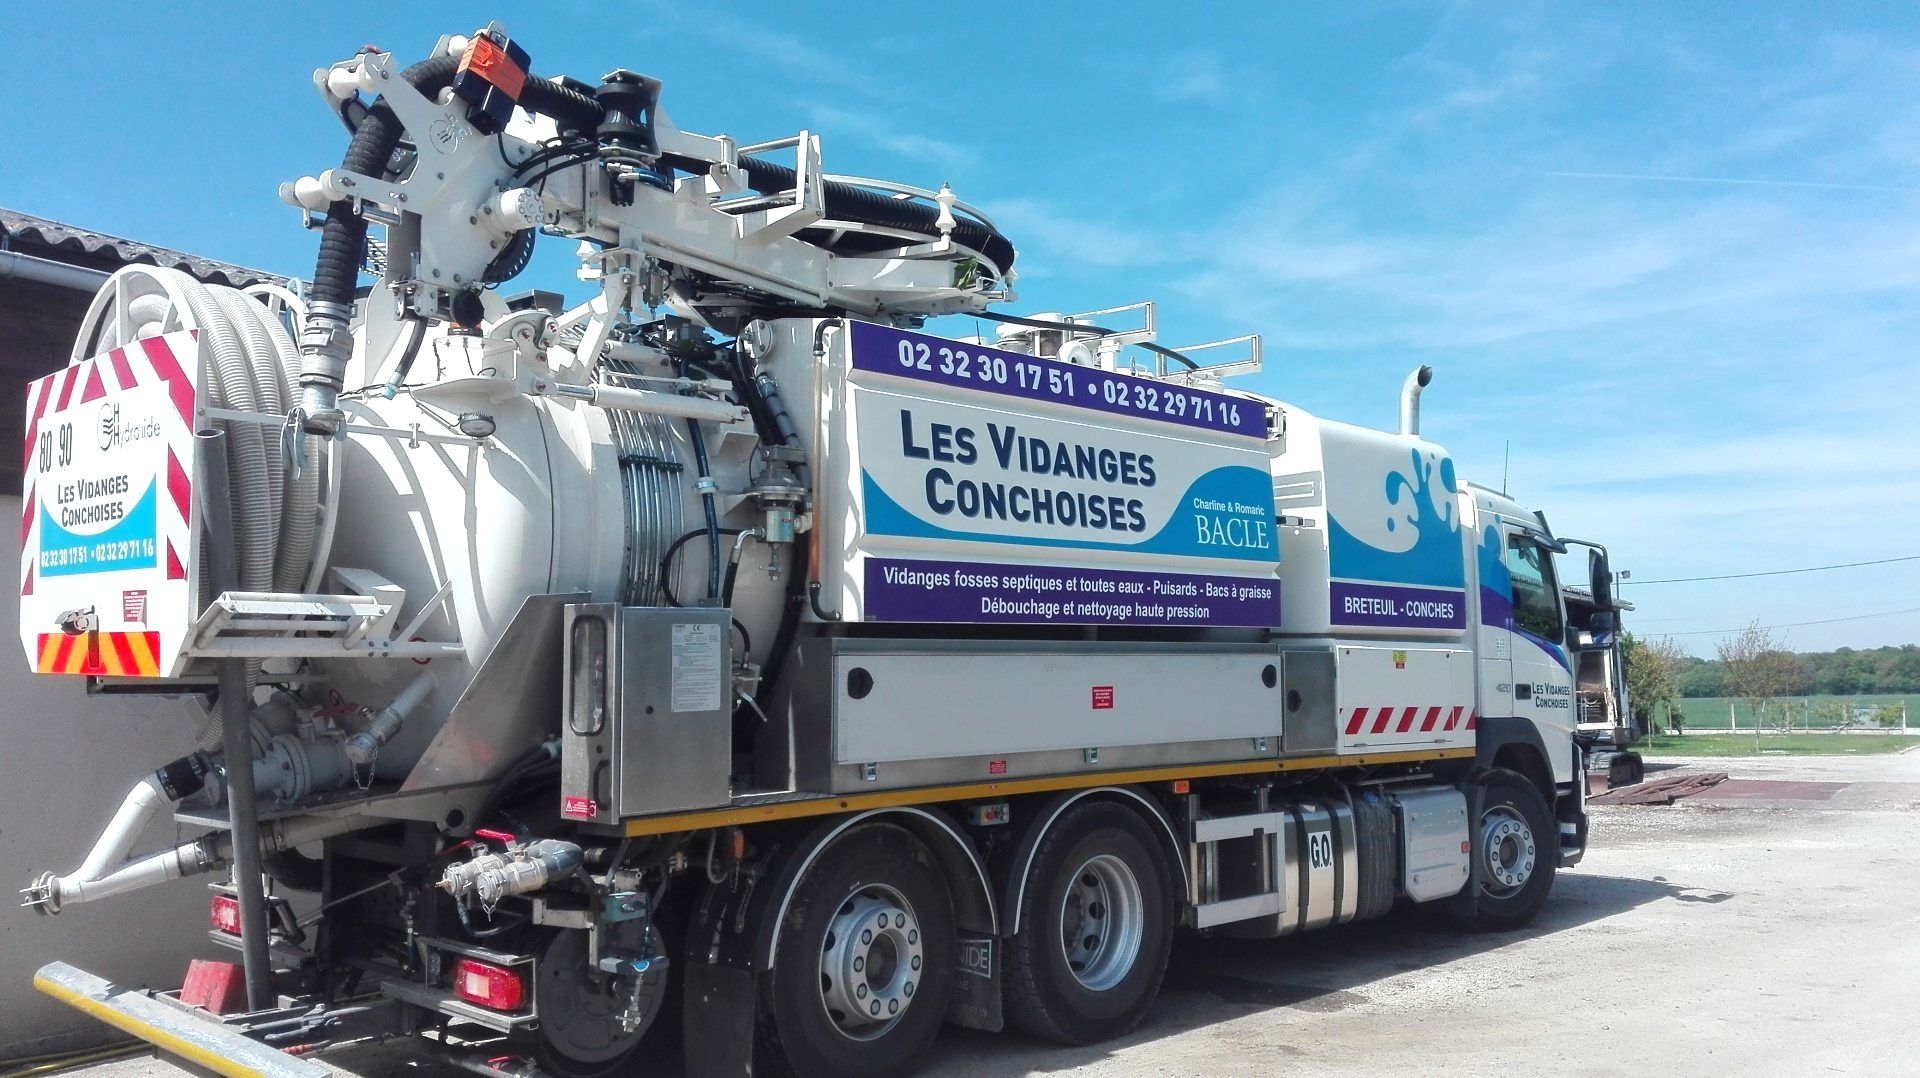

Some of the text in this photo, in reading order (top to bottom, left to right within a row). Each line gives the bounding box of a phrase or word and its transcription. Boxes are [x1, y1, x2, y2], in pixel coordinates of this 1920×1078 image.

[898, 339, 932, 371] 02
[938, 347, 971, 378] 32
[977, 355, 1008, 384] 30
[1014, 362, 1042, 390] 17
[1049, 368, 1075, 397] 51
[1103, 379, 1130, 407] 02
[1134, 385, 1159, 412] 32
[1163, 391, 1187, 416] 29
[1191, 396, 1213, 422] 71
[1219, 402, 1240, 427] 16
[40, 422, 73, 474] 80 90
[900, 409, 1157, 488] LES VIDANGES
[58, 474, 129, 504] LES VIDANGES
[925, 467, 1147, 533] CONCHOISES
[1193, 497, 1265, 516] Charline & Romaric
[62, 501, 124, 527] CONCHOISES
[1194, 514, 1269, 549] BACLE
[41, 551, 50, 567] 02
[50, 550, 59, 567] 32
[59, 548, 68, 565] 30
[95, 544, 106, 562] 02
[107, 543, 117, 560] 32
[118, 541, 128, 560] 29
[129, 540, 140, 558] 71
[142, 538, 154, 557] 16
[883, 566, 951, 590] Vidanges
[954, 569, 999, 588] fosses
[1002, 574, 1063, 593] septiques
[1065, 577, 1077, 591] et
[1079, 578, 1116, 593] toutes
[1118, 581, 1144, 594] eaux
[1153, 580, 1198, 596] Puisards
[1205, 582, 1229, 598] Bacs
[1231, 583, 1237, 598] à
[1239, 585, 1272, 602] graisse
[981, 596, 1210, 620] Débouchage et nettoyage haute pression
[1344, 596, 1398, 616] BRETEUIL
[1406, 600, 1454, 619] CONCHES
[1310, 833, 1332, 869] G.O.
